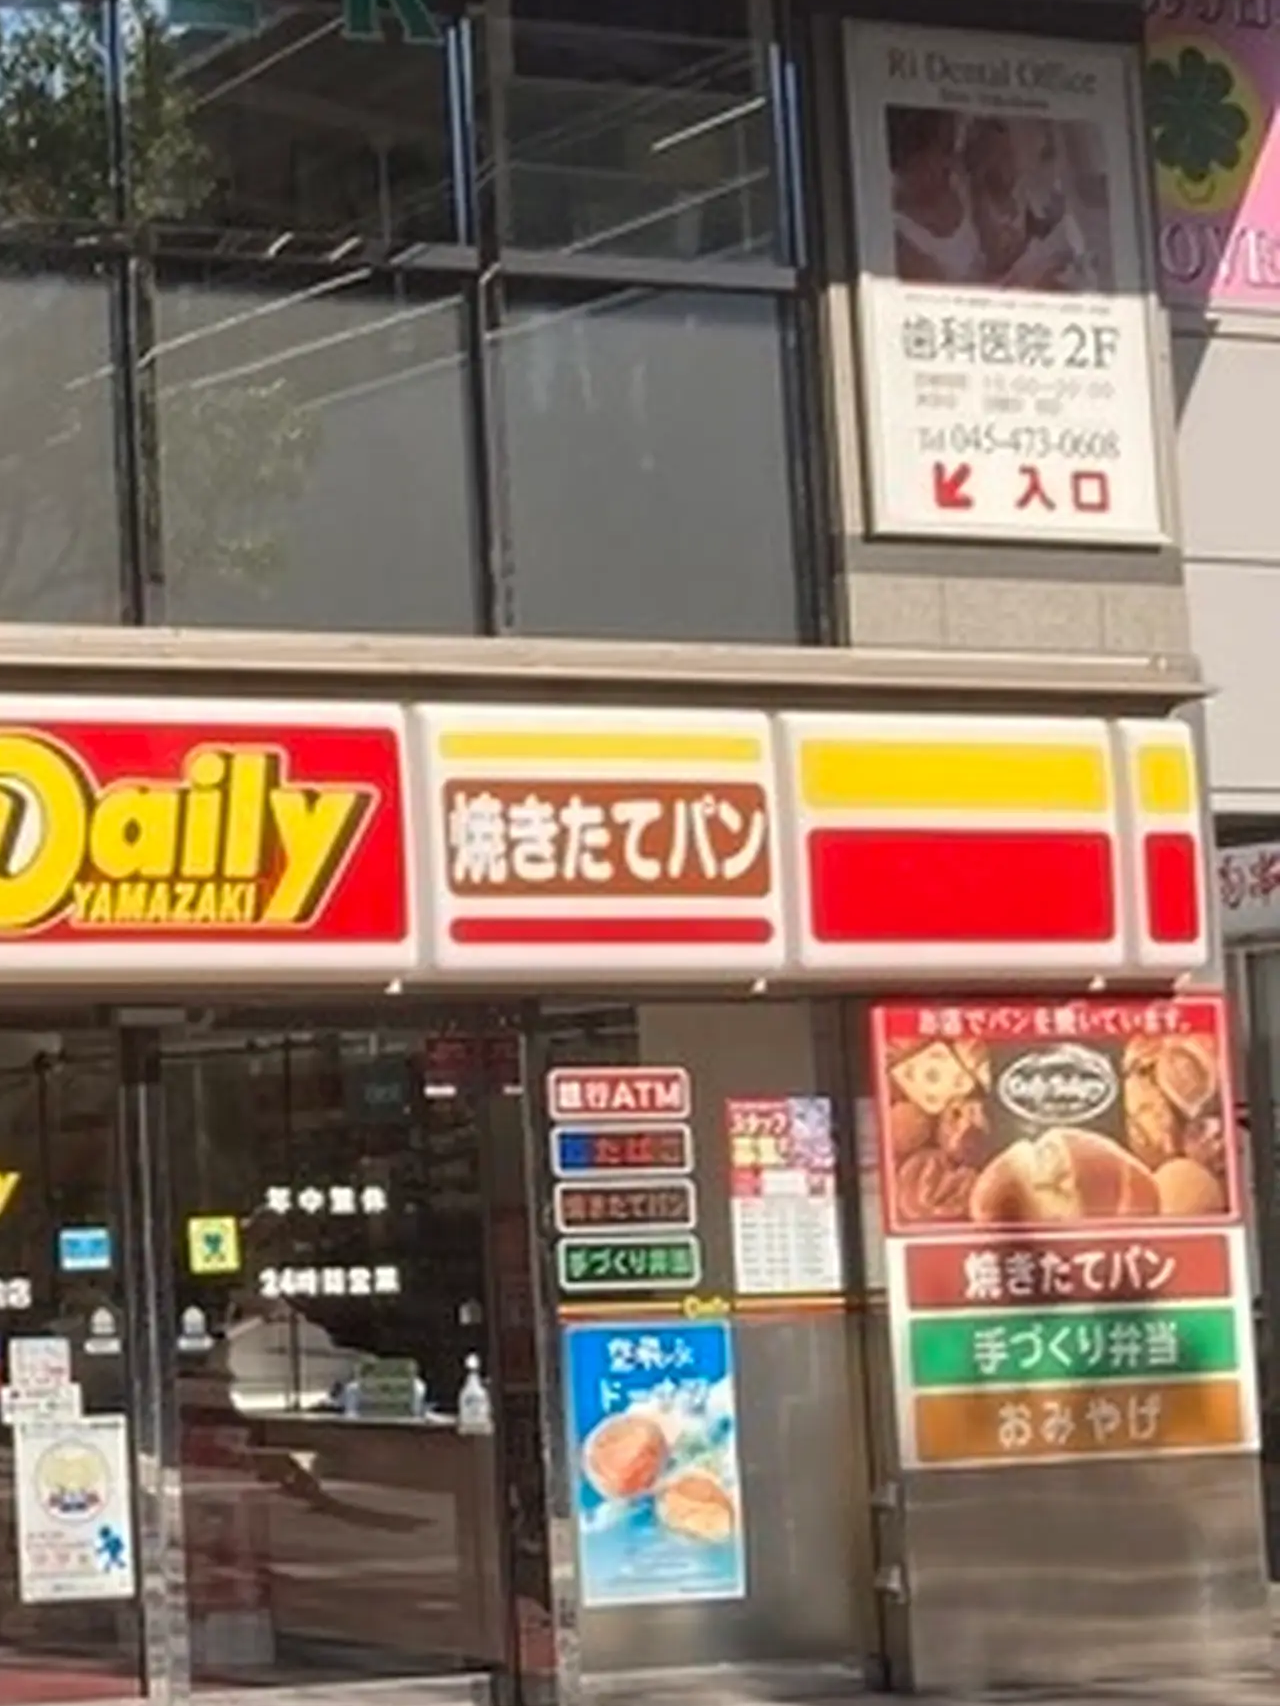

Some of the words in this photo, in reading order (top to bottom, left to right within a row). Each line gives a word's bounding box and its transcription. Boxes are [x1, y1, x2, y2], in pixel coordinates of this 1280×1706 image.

[925, 51, 1009, 92] Dental
[1015, 61, 1097, 96] Office
[901, 317, 1053, 367] 歯科医院
[1063, 328, 1121, 370] 2F
[1015, 464, 1109, 513] 入口
[451, 791, 765, 883] 焼きたてパン
[74, 881, 257, 924] YAMAZAKI
[559, 1080, 681, 1110] 銀行ATM
[964, 1246, 1177, 1300] 焼きたてパン
[974, 1321, 1179, 1374] 手づくり弁当
[999, 1394, 1161, 1449] おみやげ
